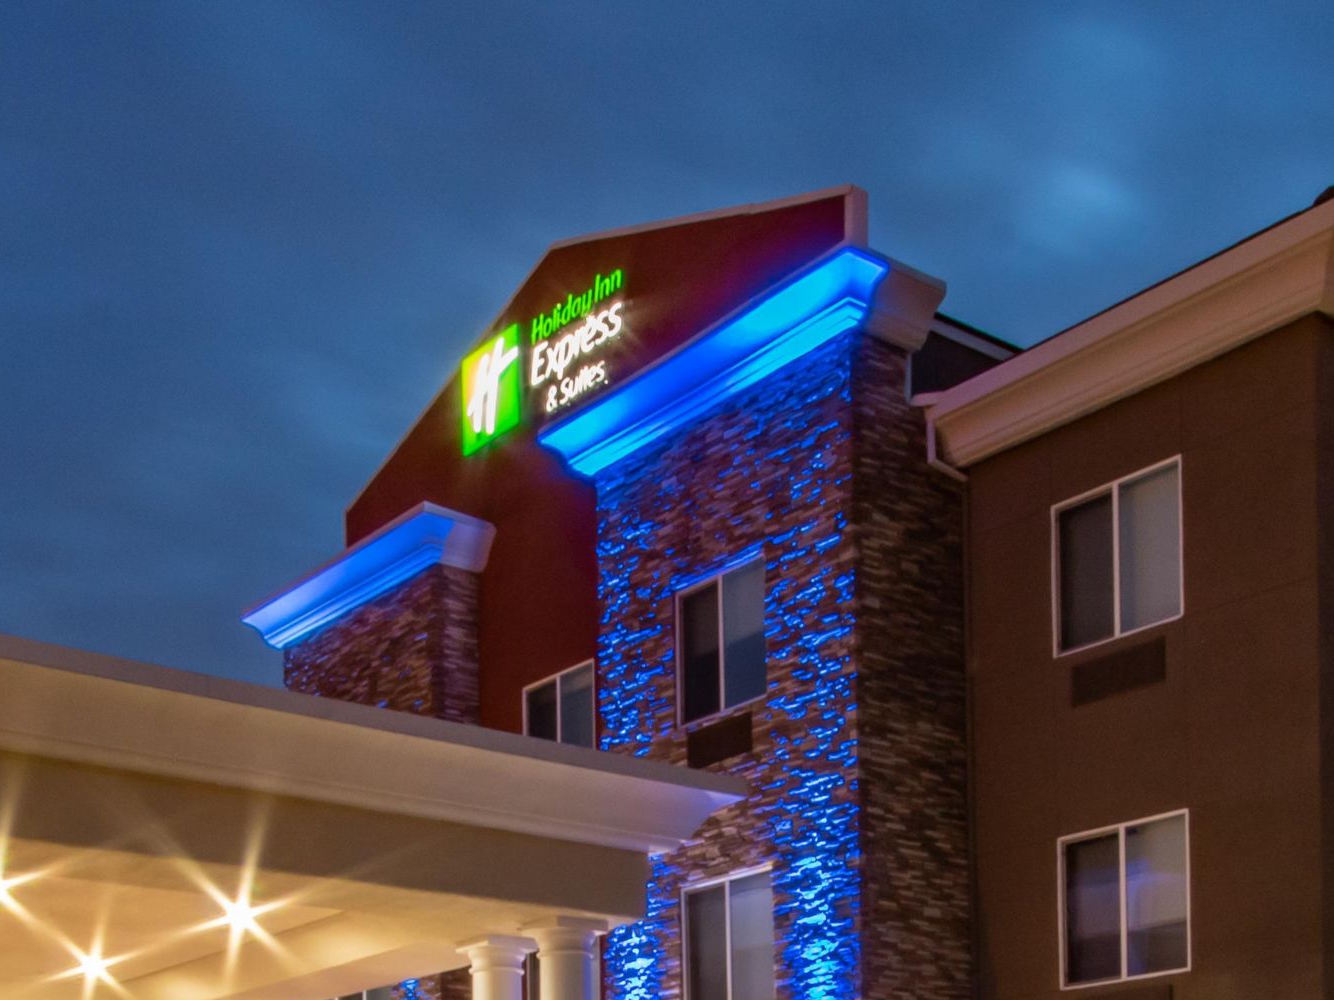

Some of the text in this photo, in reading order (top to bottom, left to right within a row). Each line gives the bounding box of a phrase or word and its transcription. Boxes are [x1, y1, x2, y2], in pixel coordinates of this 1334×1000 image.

[531, 269, 622, 345] Holiday Inn
[531, 301, 623, 387] Express
[546, 384, 559, 412] &
